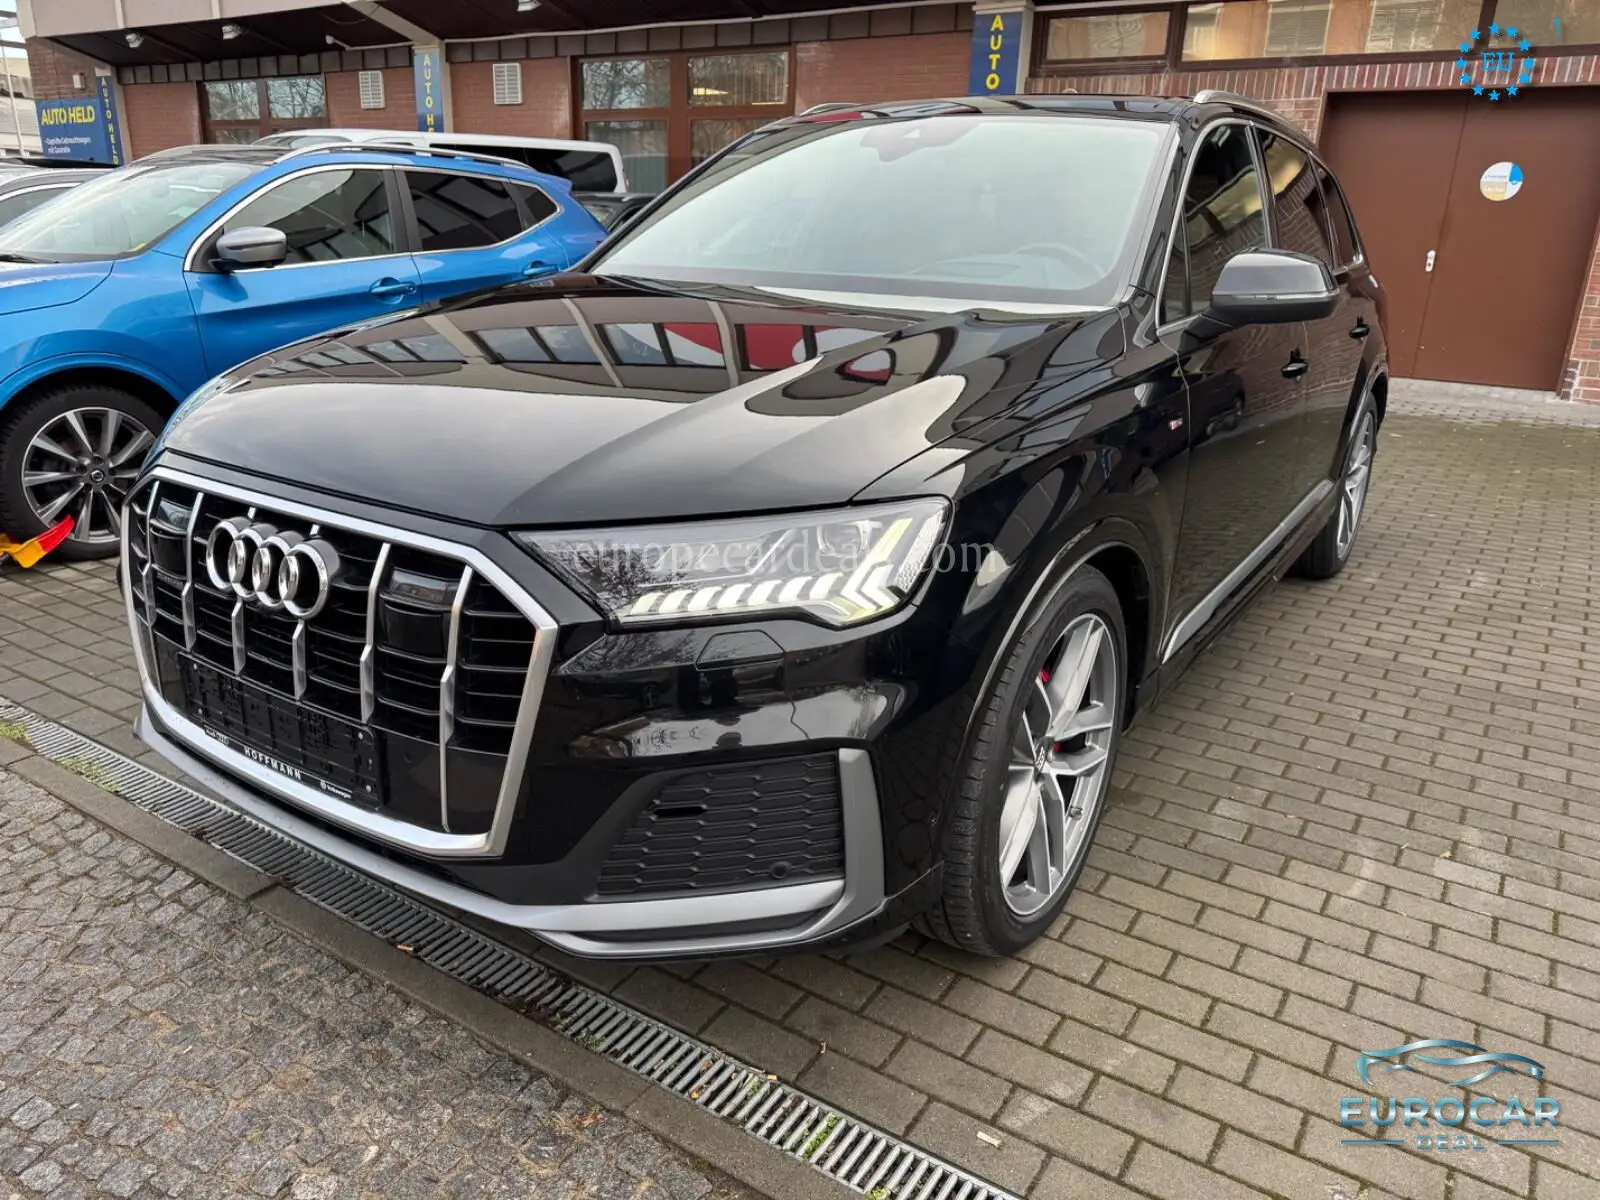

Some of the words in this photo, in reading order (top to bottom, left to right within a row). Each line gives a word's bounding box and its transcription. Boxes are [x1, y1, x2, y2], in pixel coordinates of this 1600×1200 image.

[985, 14, 1004, 90] AUTO
[423, 54, 434, 108] AUTO
[41, 107, 67, 126] AUTO
[68, 105, 96, 125] HELD
[101, 76, 112, 120] AUTO
[108, 122, 119, 165] HELD
[244, 745, 301, 780] HOFFMANN
